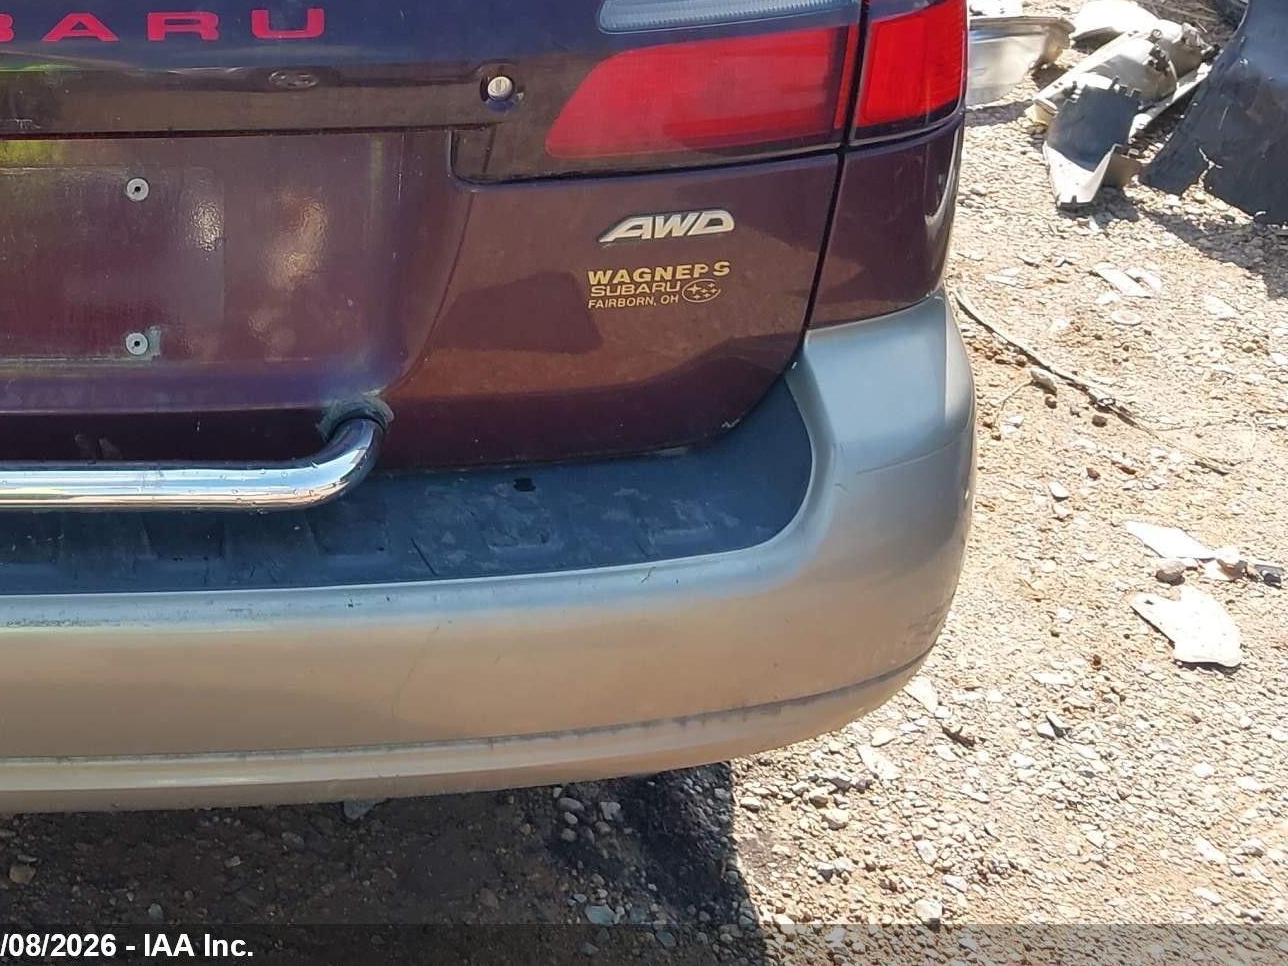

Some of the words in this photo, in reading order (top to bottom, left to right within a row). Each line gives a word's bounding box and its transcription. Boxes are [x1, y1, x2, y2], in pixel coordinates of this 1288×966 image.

[598, 209, 735, 242] AWD
[590, 280, 681, 297] SUBARU
[660, 294, 680, 305] OH
